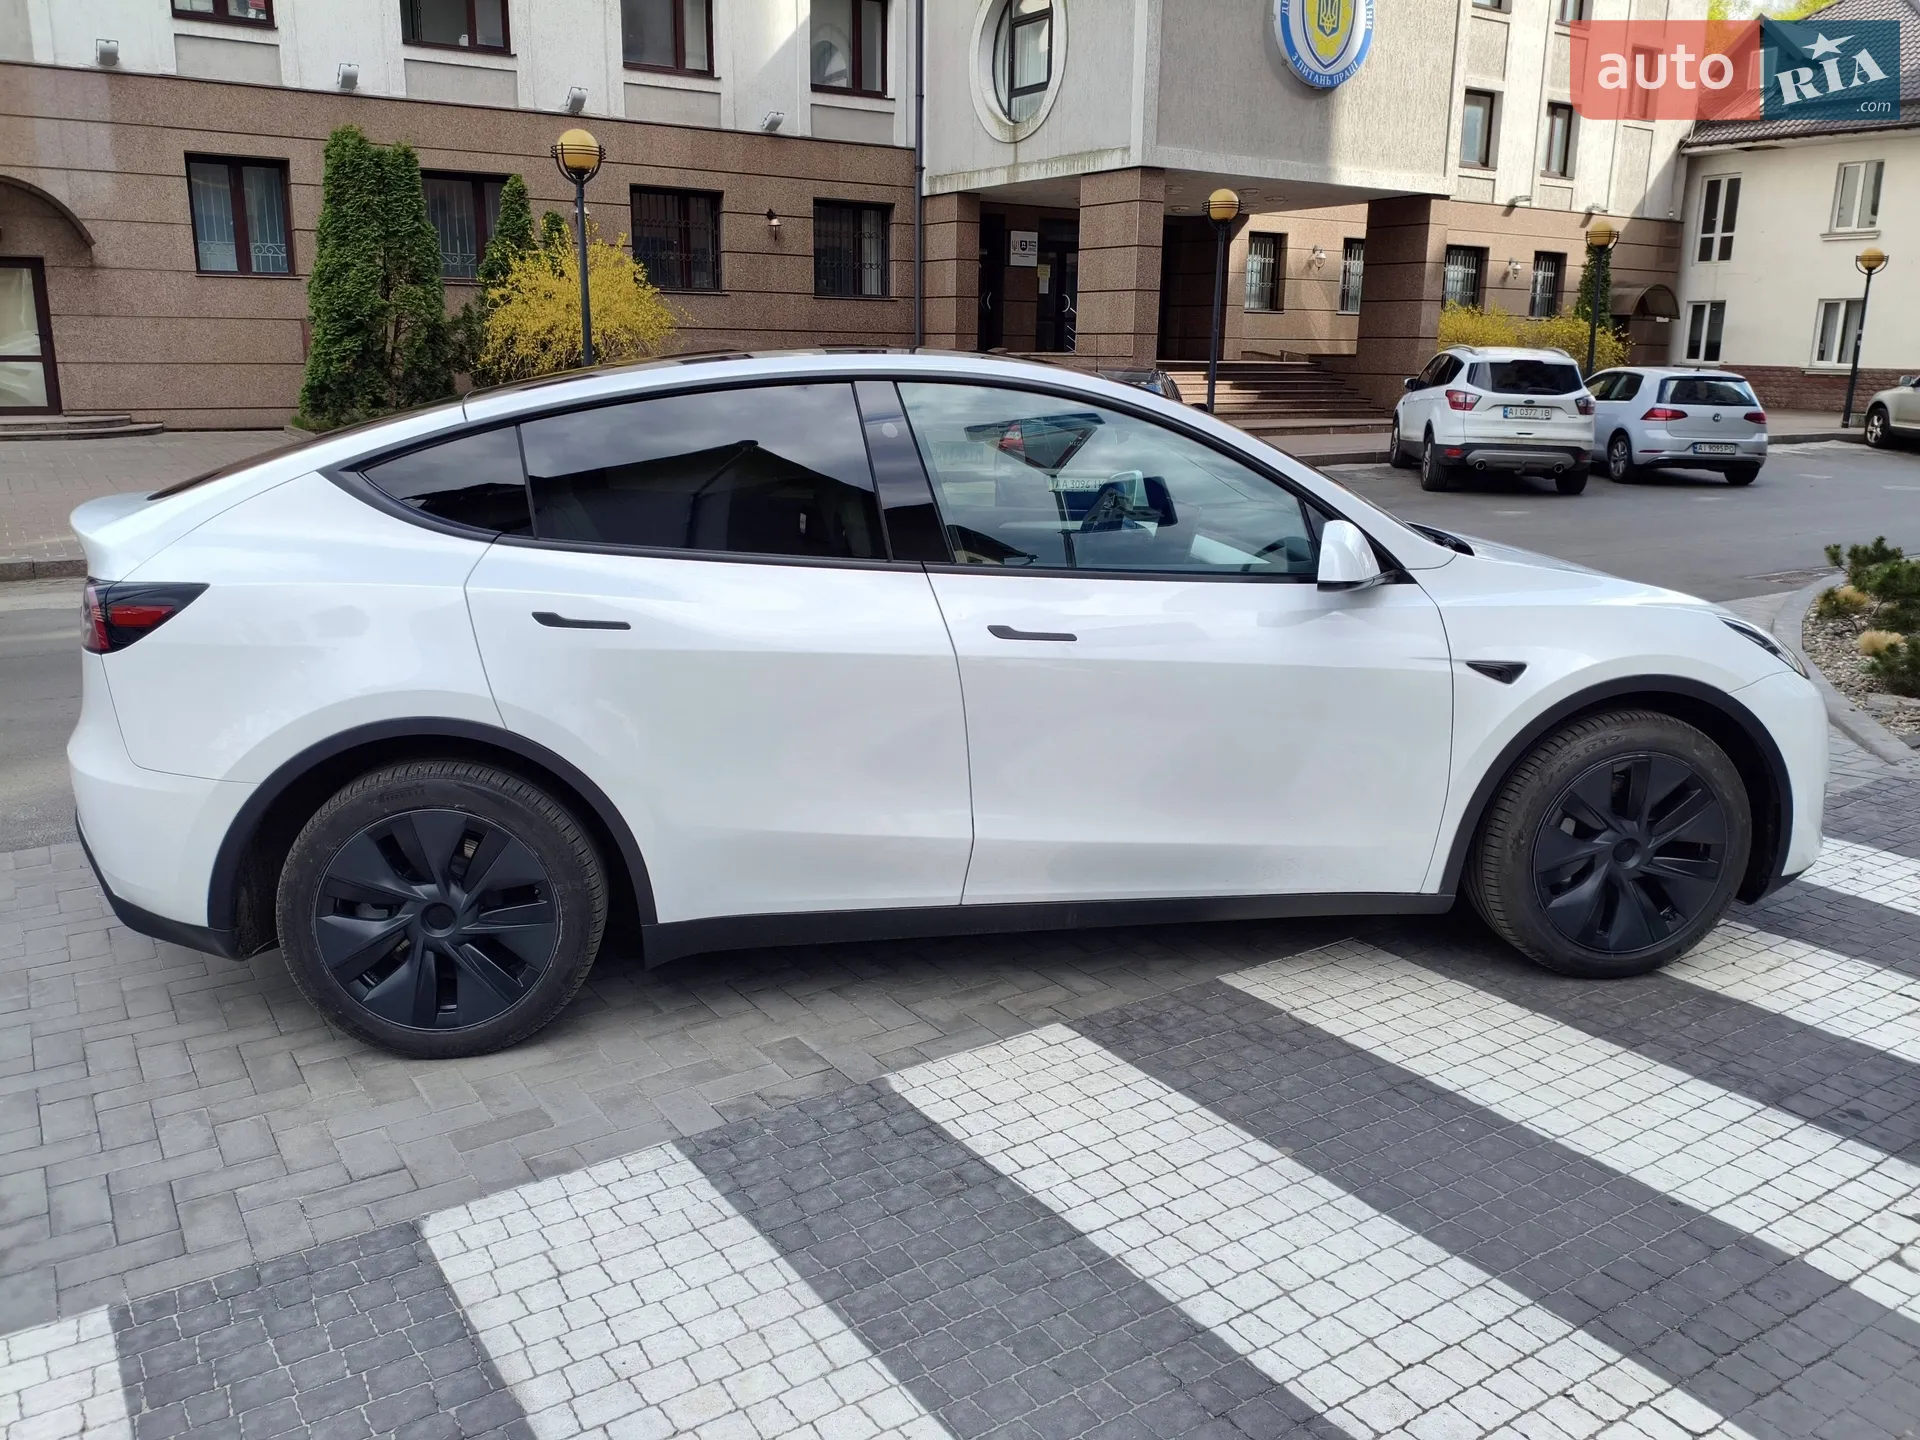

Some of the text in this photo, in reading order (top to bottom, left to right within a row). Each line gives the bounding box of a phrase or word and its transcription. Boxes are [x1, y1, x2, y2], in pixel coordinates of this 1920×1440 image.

[1296, 59, 1331, 85] ПИТАНЬ
[1333, 60, 1359, 85] ПРАЦІ
[1520, 408, 1537, 416] 0377
